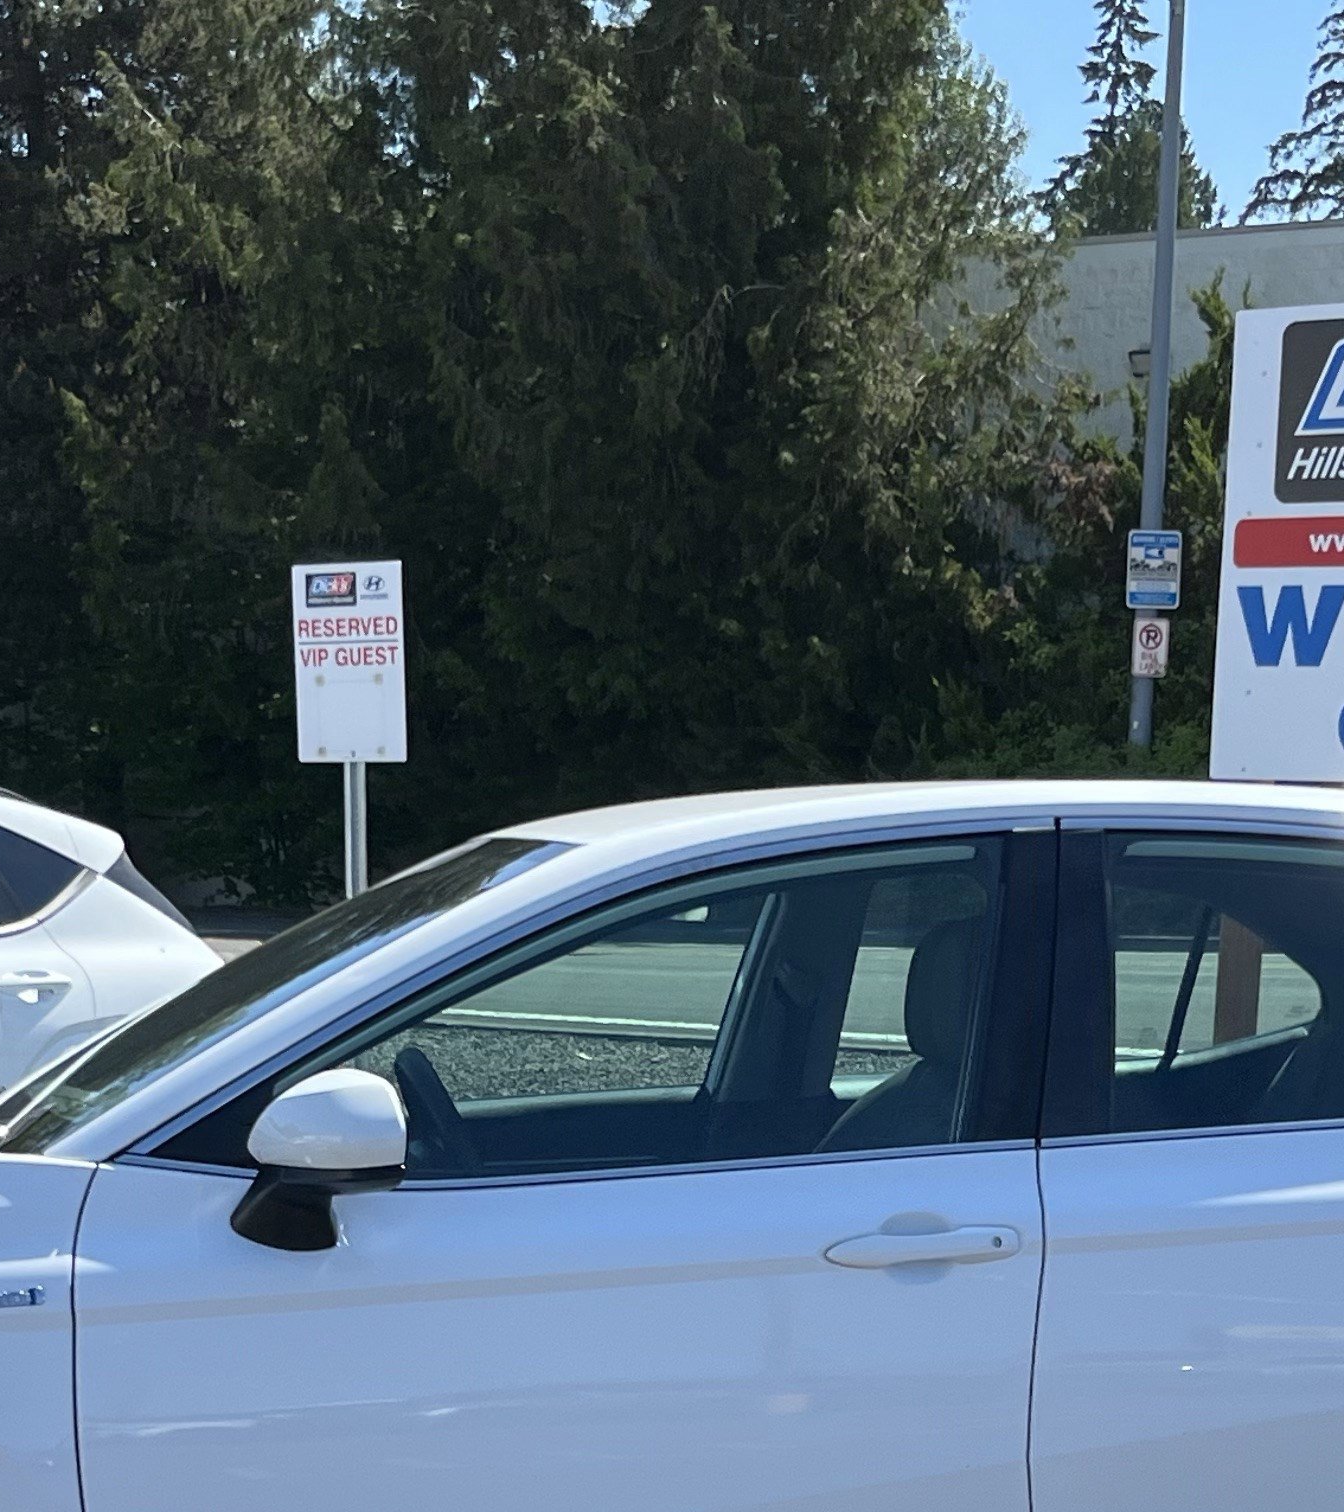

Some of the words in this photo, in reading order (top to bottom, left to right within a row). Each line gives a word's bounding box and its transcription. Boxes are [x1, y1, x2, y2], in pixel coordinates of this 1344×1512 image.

[298, 616, 398, 638] RESERVED
[300, 648, 329, 667] VIP
[335, 646, 399, 667] GUEST
